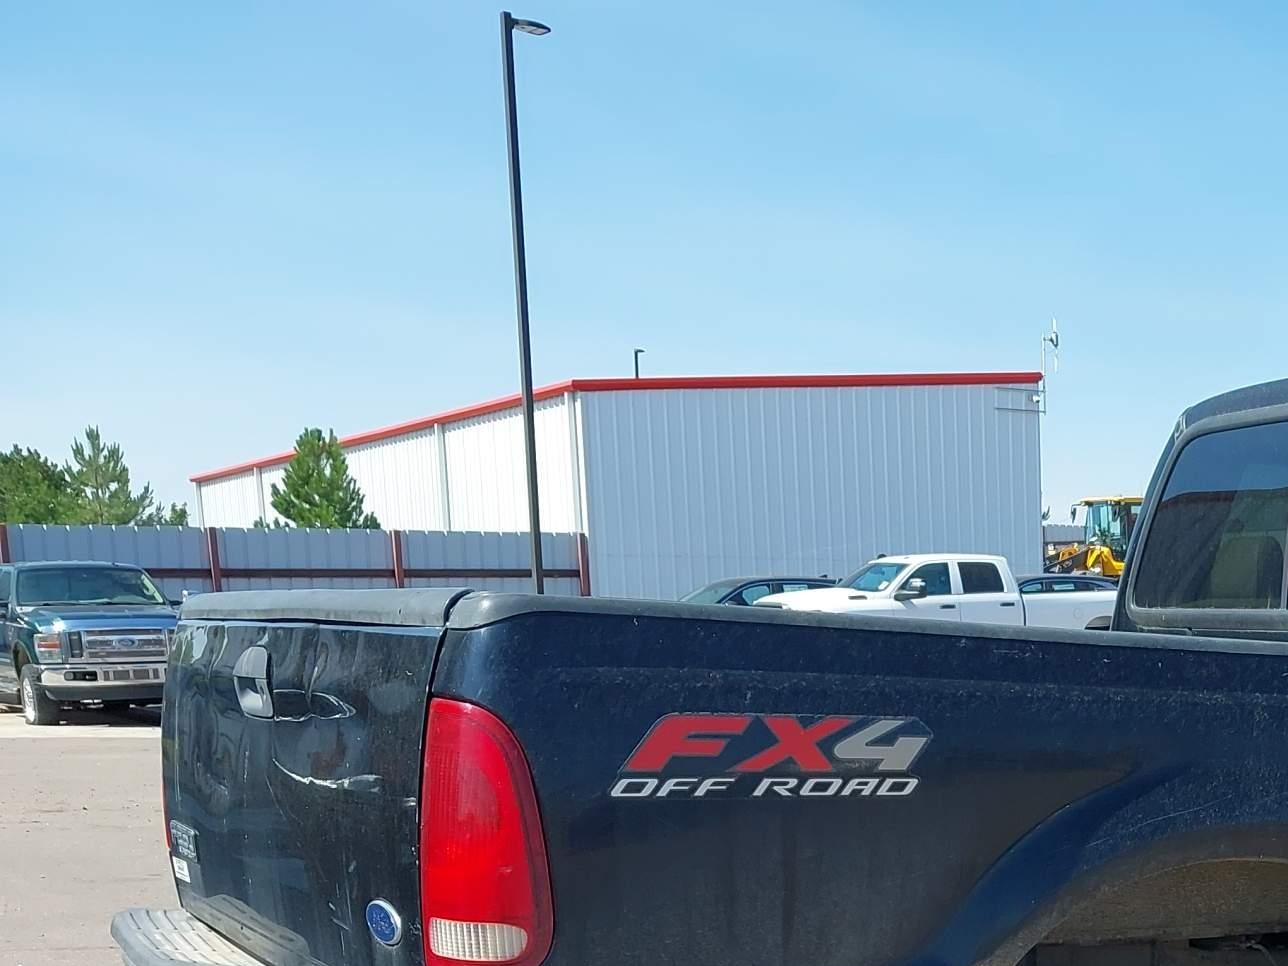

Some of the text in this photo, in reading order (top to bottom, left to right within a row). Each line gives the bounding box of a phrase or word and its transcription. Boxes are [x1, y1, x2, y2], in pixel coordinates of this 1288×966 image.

[621, 712, 931, 772] FX4
[610, 777, 920, 797] OFF ROAD
